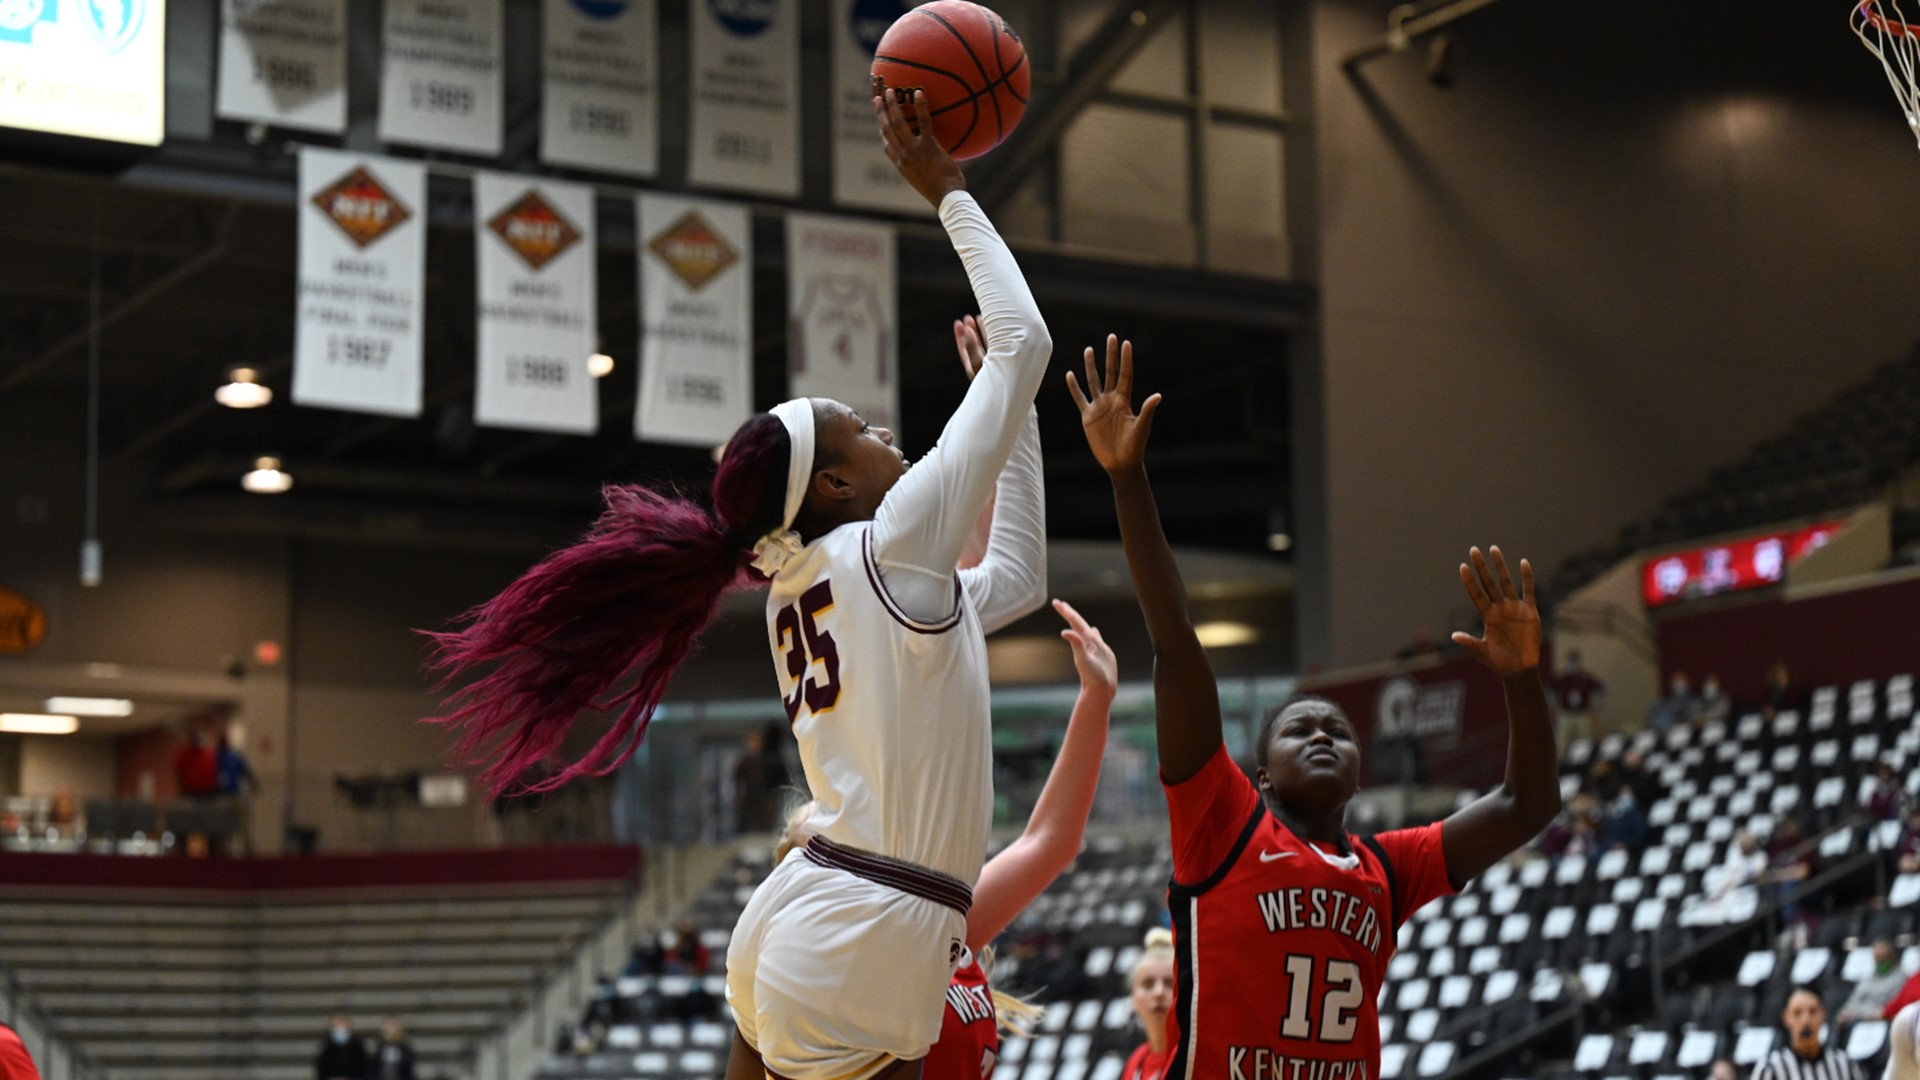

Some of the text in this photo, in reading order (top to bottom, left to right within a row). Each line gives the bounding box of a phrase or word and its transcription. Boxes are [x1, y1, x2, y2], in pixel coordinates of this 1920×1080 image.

[327, 334, 393, 369] 1987
[775, 578, 844, 727] 35
[1257, 886, 1382, 955] WESTERN
[1281, 954, 1364, 1042] 12
